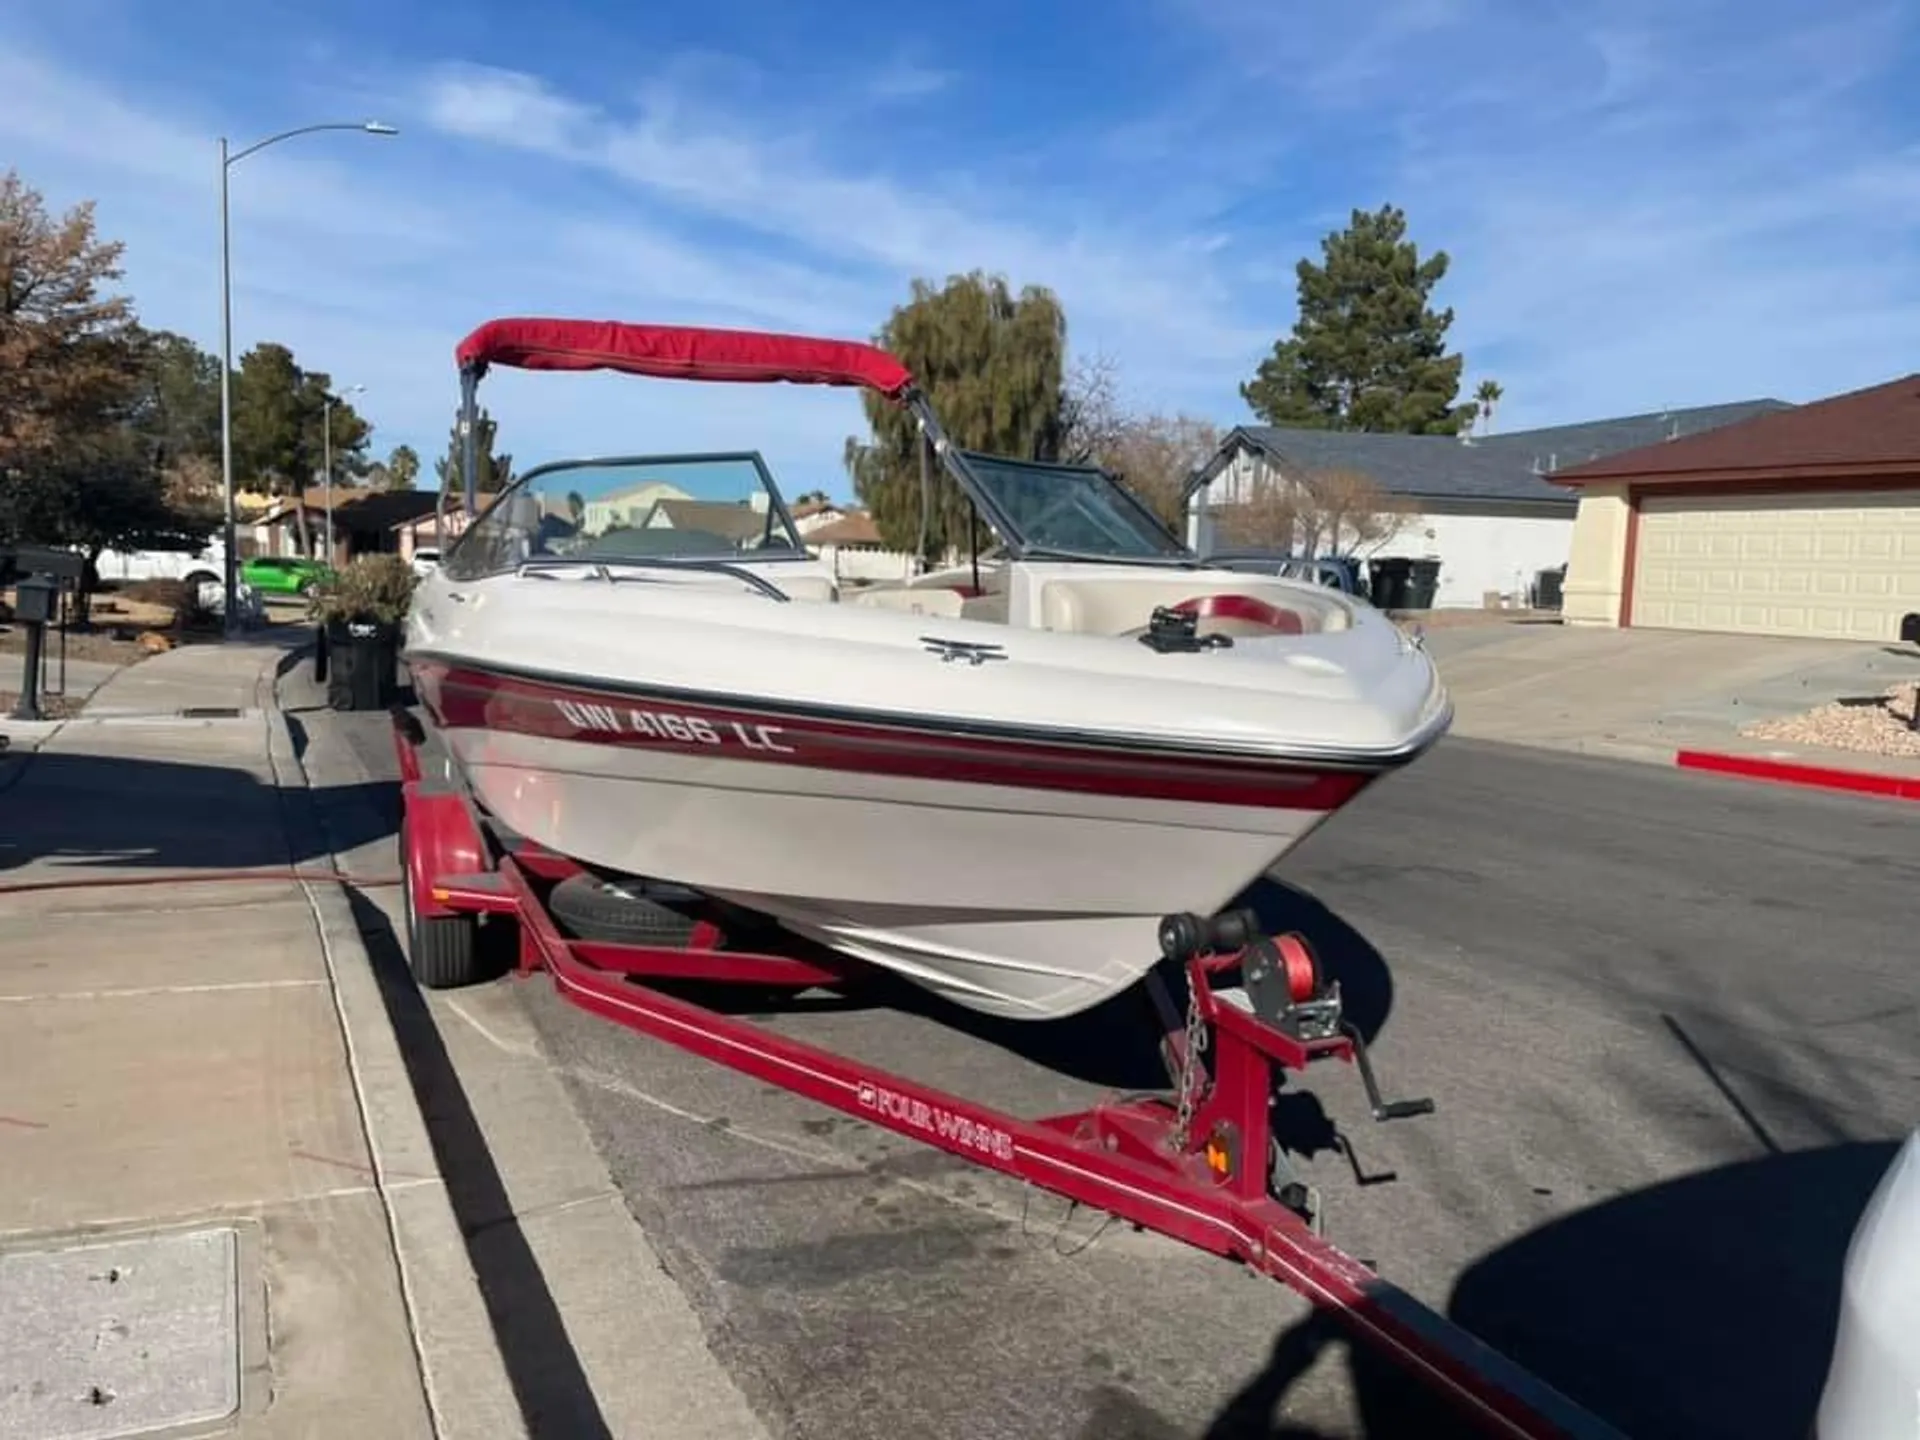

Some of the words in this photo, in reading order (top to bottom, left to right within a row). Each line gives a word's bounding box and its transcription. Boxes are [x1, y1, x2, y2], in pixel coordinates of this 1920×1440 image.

[630, 709, 721, 744] 4166
[731, 721, 795, 753] LC
[877, 1088, 935, 1133] FOUR
